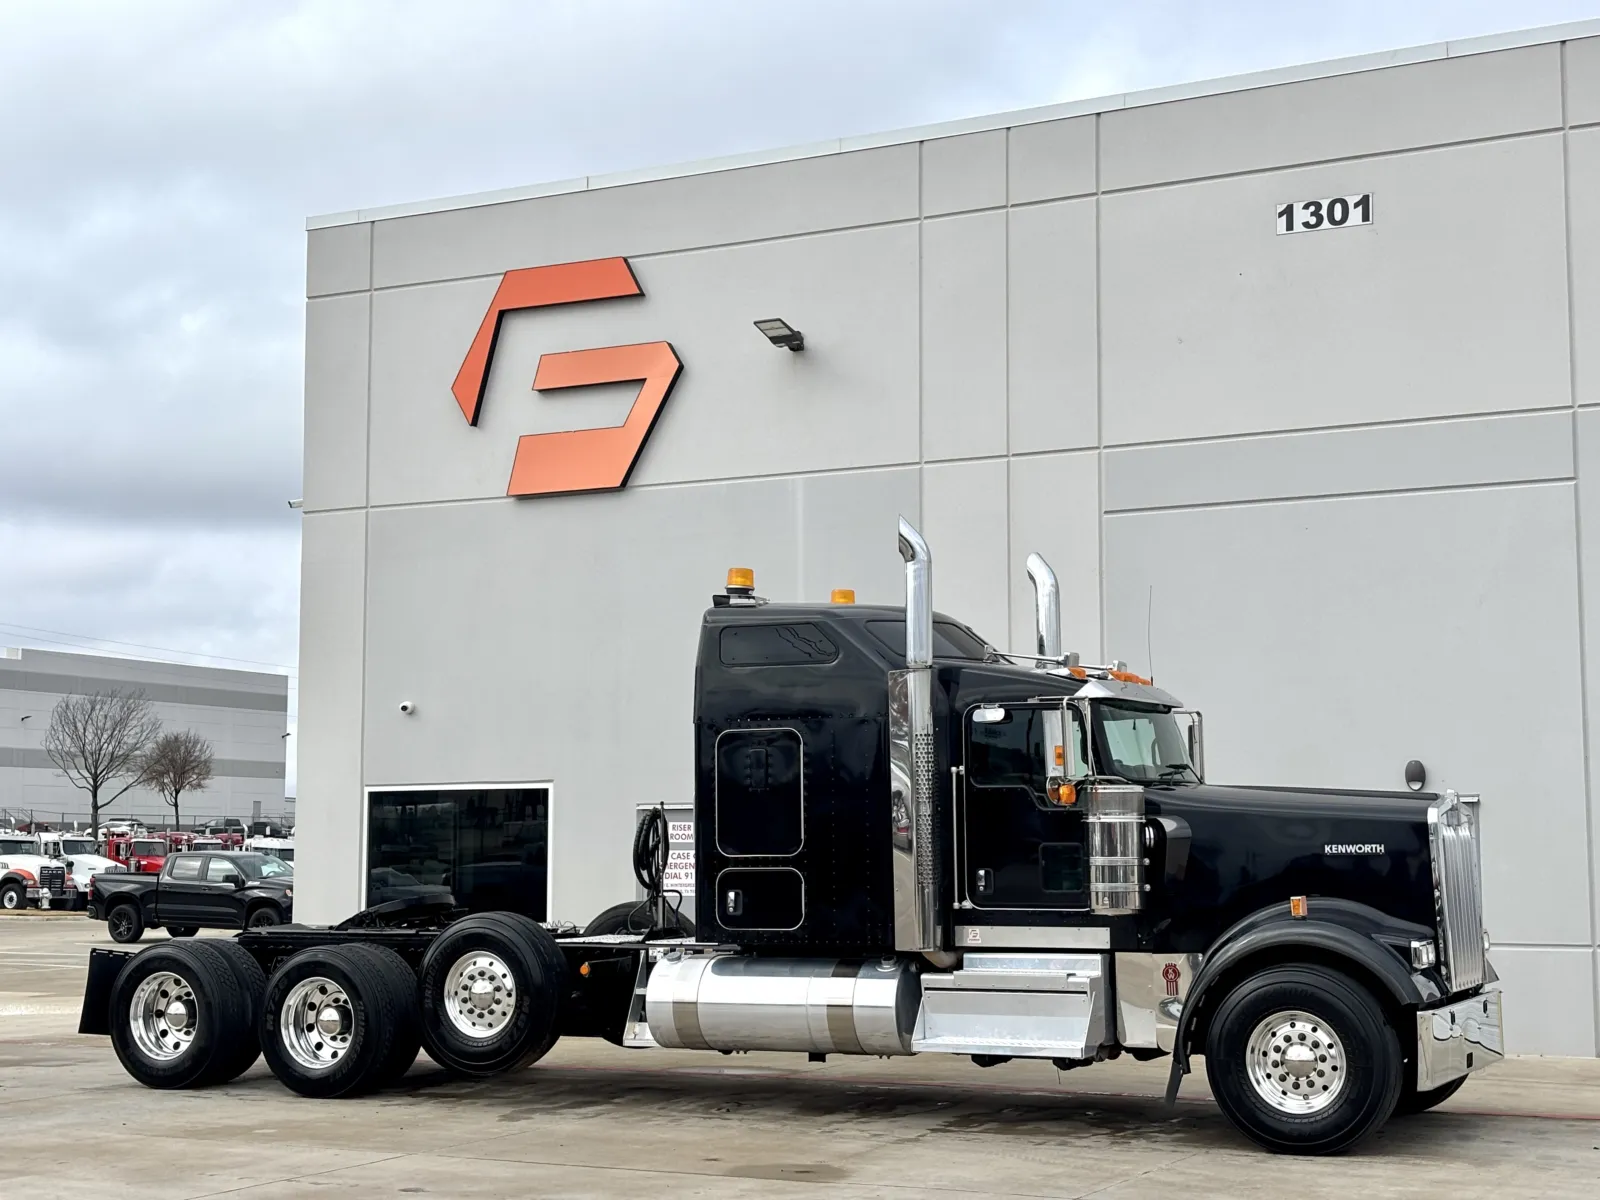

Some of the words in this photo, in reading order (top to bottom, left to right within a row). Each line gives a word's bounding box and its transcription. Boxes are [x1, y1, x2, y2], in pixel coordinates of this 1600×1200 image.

[1278, 194, 1370, 232] 1301
[671, 824, 692, 832] RISER
[669, 833, 694, 841] ROOM
[1324, 844, 1385, 854] KENWORTH
[670, 852, 691, 860] CASE
[664, 872, 682, 880] DIAL
[684, 872, 694, 880] 91
